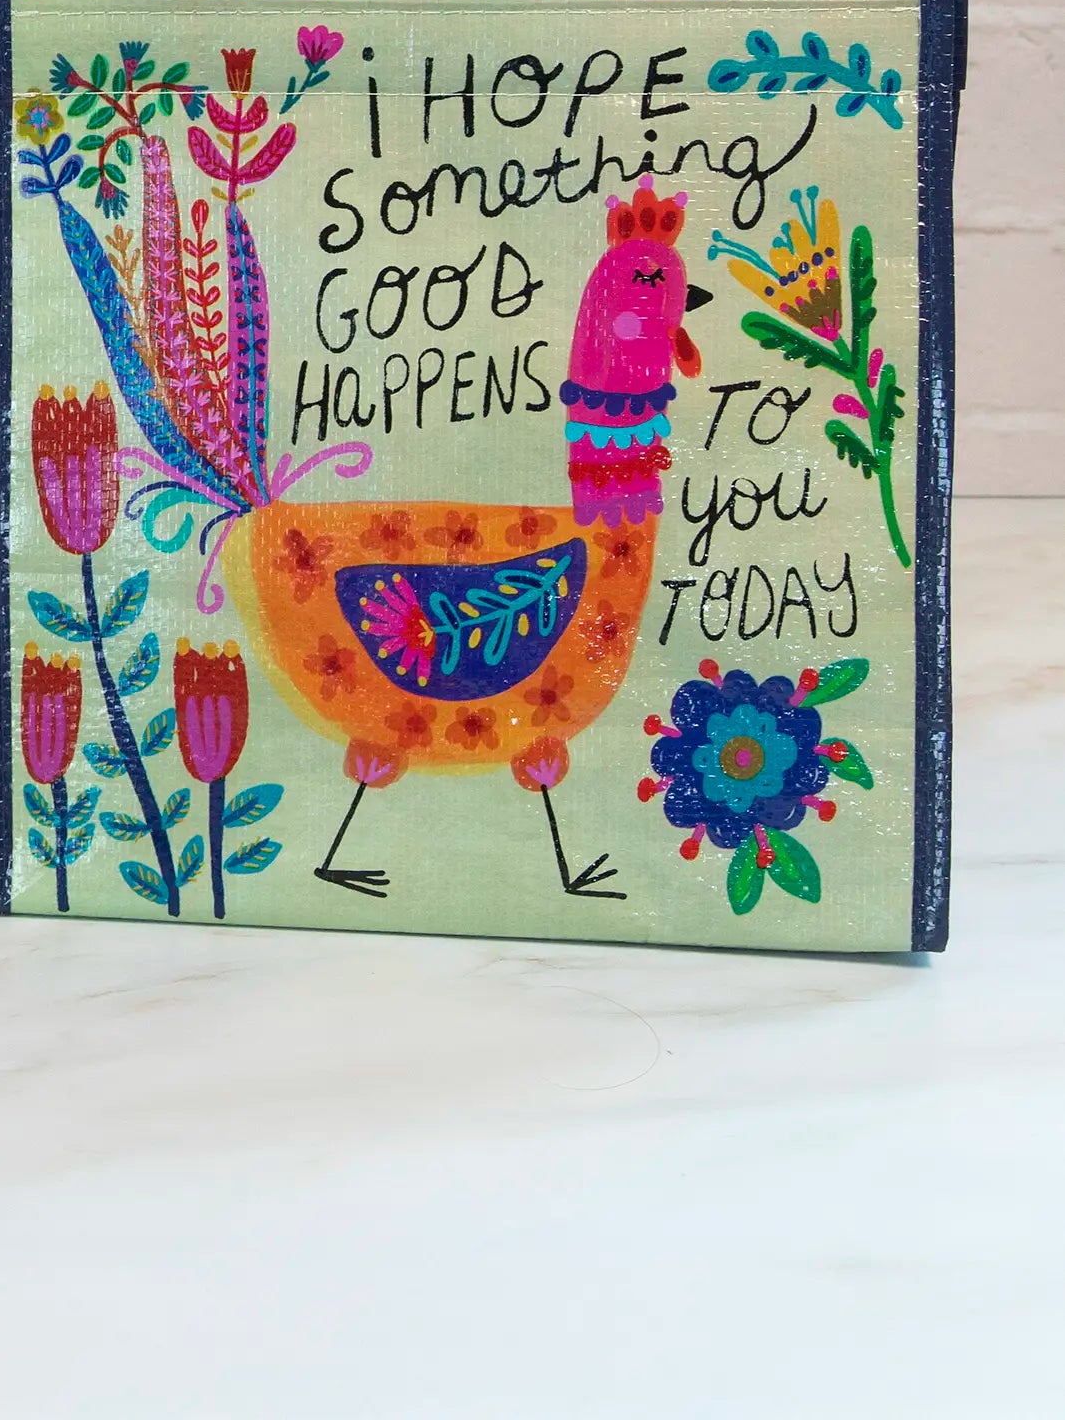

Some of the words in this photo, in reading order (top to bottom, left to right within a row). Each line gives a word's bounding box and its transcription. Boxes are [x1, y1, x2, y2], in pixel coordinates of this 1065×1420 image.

[423, 47, 690, 144] HOPE
[317, 104, 817, 254] Something
[315, 242, 544, 353] GOOD
[705, 380, 812, 450] TO
[681, 468, 827, 567] you
[659, 553, 858, 645] TODAY
